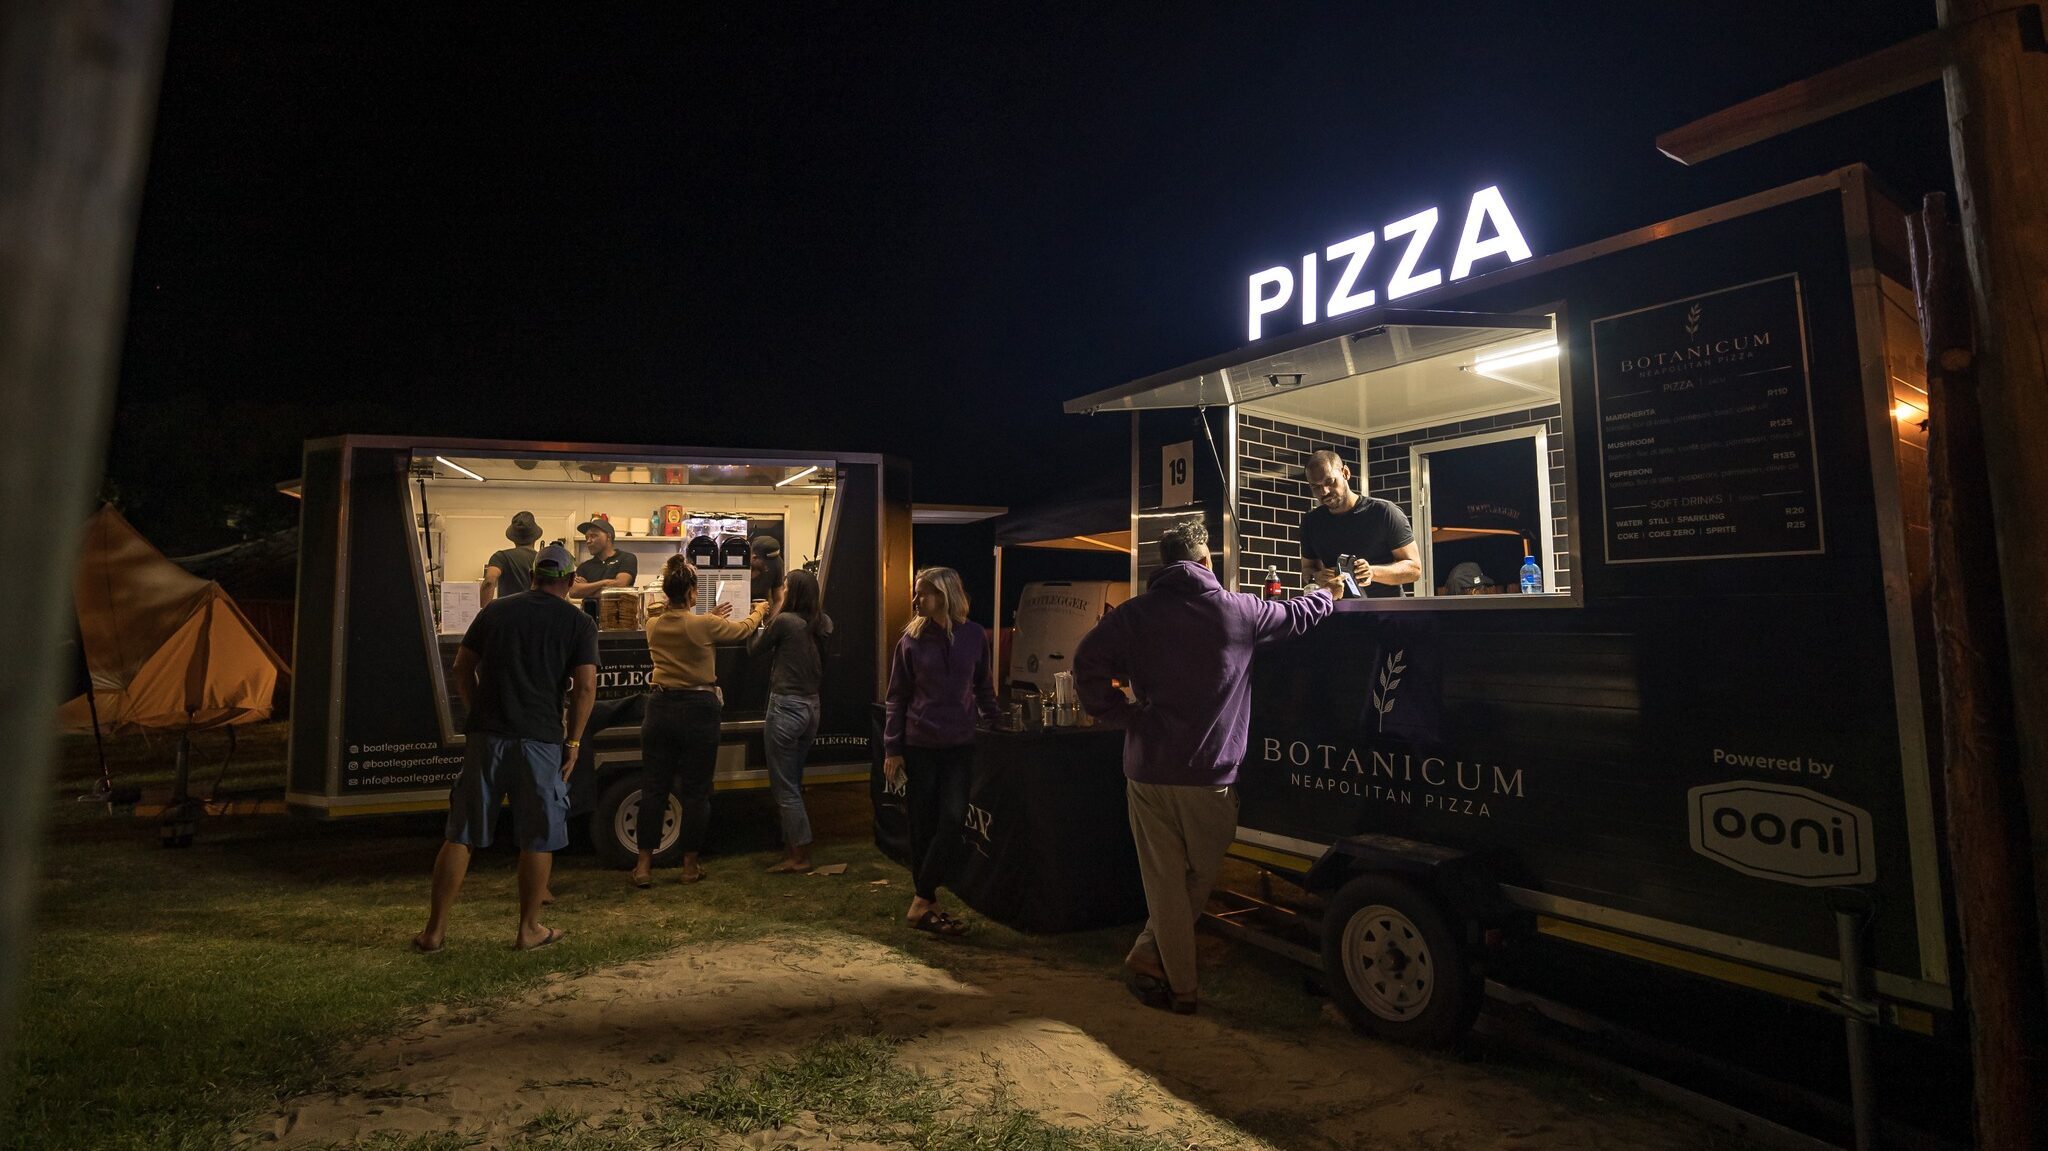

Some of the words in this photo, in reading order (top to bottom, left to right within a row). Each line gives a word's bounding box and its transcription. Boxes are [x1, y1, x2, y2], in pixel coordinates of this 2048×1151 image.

[1249, 185, 1532, 341] PIZZA
[1621, 331, 1771, 372] BOTANICUM
[1639, 359, 1711, 378] NEAPOLITAN
[1718, 352, 1754, 364] PIZZA
[1663, 380, 1694, 392] PIZZA
[1767, 387, 1788, 397] R110
[1605, 408, 1656, 422] MARGHERITA
[1769, 418, 1793, 429] R125
[1608, 437, 1655, 450] MUSHROOM
[1169, 458, 1187, 486] 19
[1609, 467, 1653, 479] PEPPERONI
[1650, 499, 1679, 510] SOFT
[1681, 495, 1723, 507] DRINKS
[1785, 507, 1805, 515] R20
[1616, 519, 1643, 528] WATER
[1648, 518, 1670, 526] STILL
[1677, 513, 1726, 524] SPARKLING
[1786, 521, 1806, 529] R25
[1617, 532, 1639, 540] COKE
[1648, 530, 1671, 538] COKE
[1673, 528, 1696, 537] ZERO
[1705, 525, 1737, 535] SPRITE
[363, 742, 438, 753] bootlegger.co.za
[1264, 737, 1524, 798] BOTANICUM
[1713, 749, 1800, 773] Powered
[1808, 757, 1834, 779] by
[1291, 773, 1411, 805] NEAPOLITAN
[1425, 794, 1490, 818] PIZZA
[1713, 807, 1844, 856] ooni
